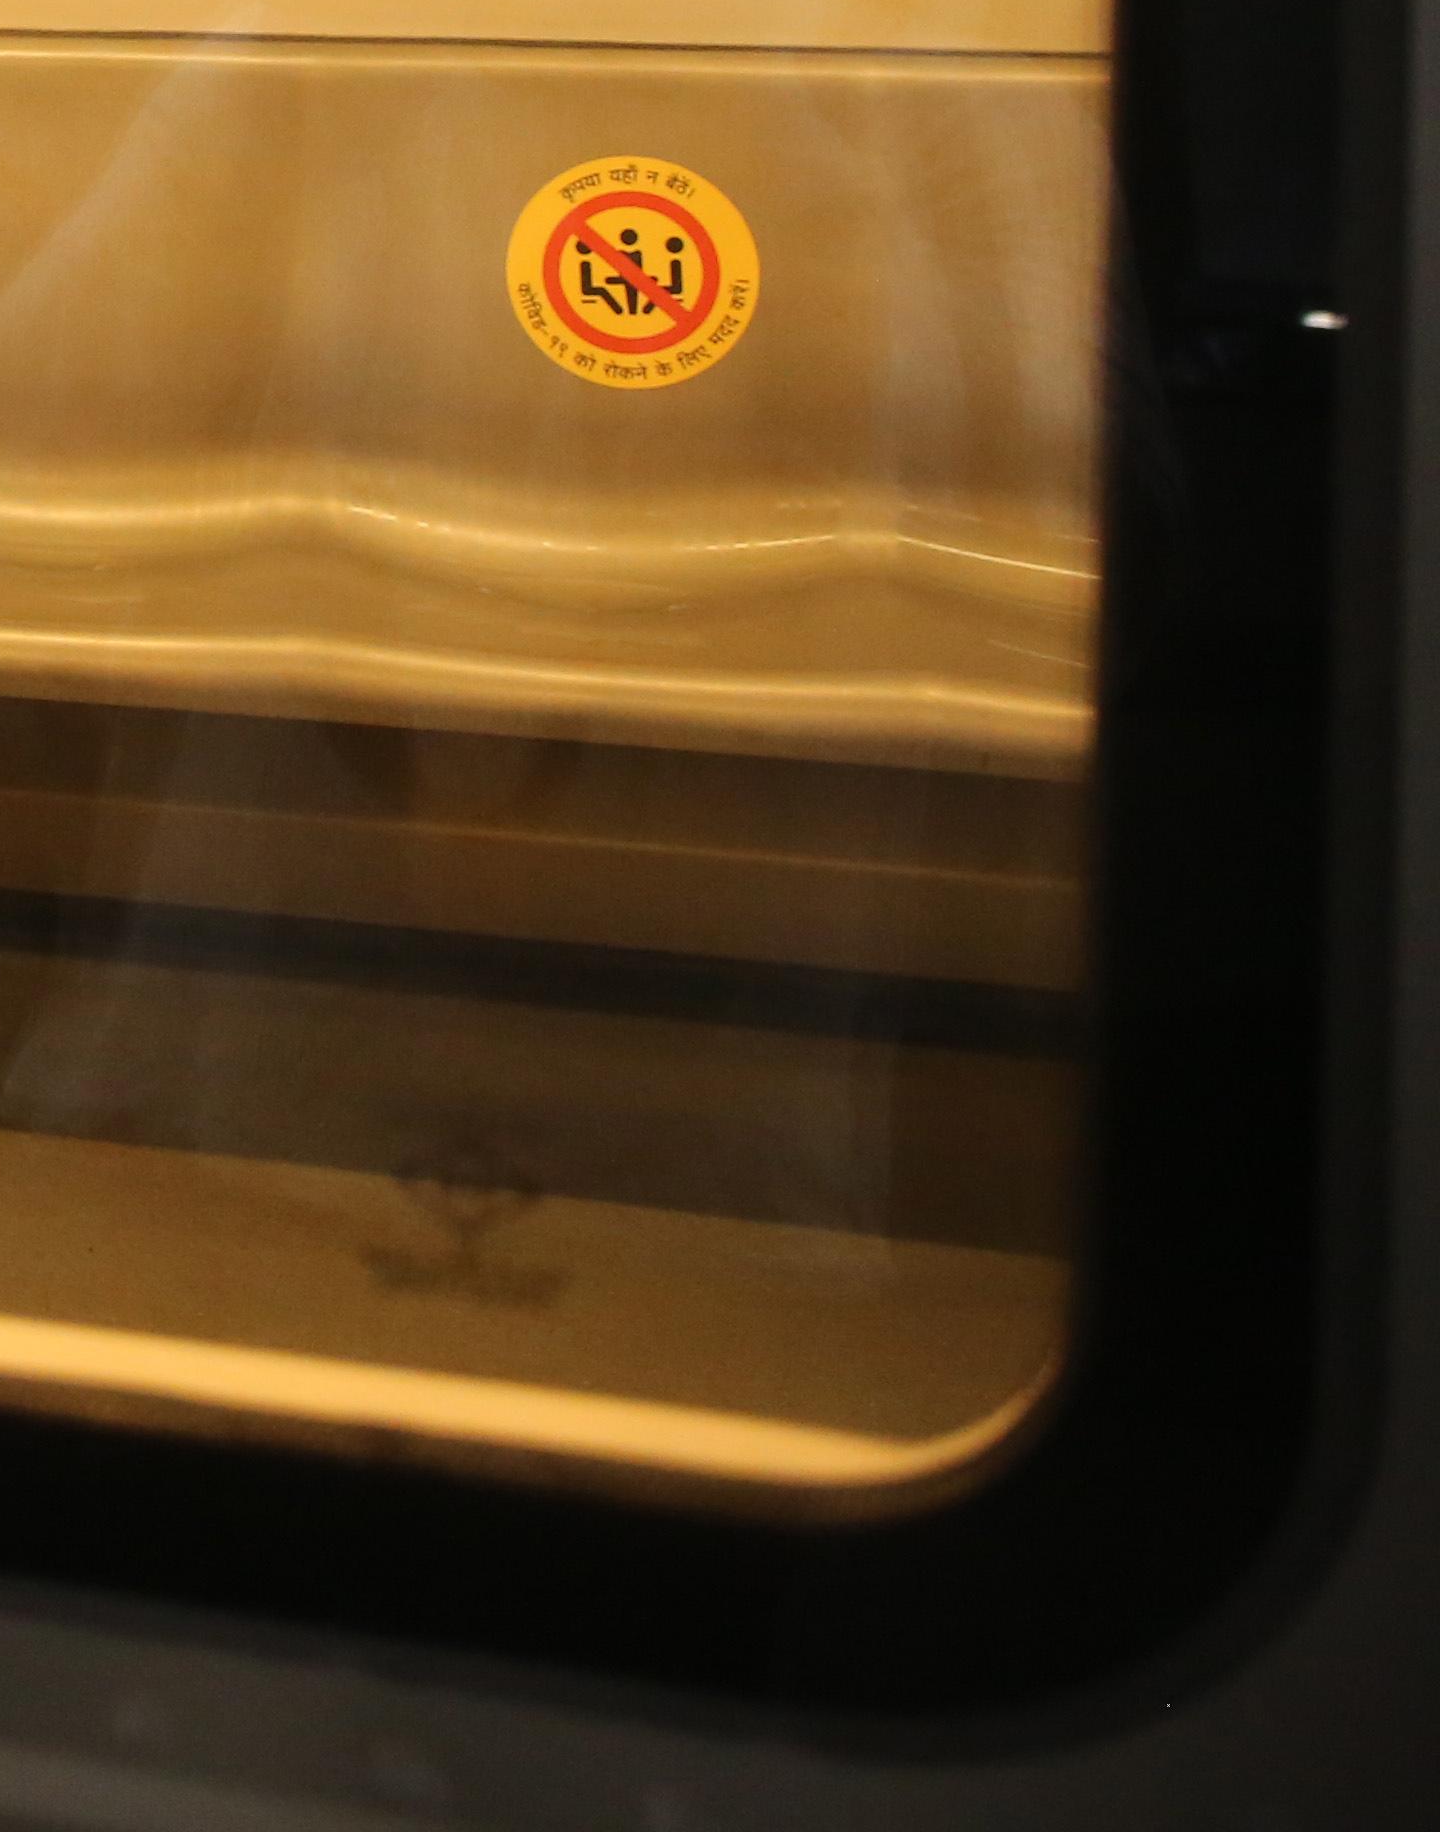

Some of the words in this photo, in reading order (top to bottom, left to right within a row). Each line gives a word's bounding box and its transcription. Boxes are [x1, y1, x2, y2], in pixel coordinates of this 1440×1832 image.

[558, 172, 601, 203] कृपया
[646, 170, 659, 184] न
[573, 351, 597, 372] को
[603, 360, 648, 380] रोकने
[654, 360, 673, 377] के
[676, 344, 712, 370] लिए
[707, 314, 741, 345] मदद
